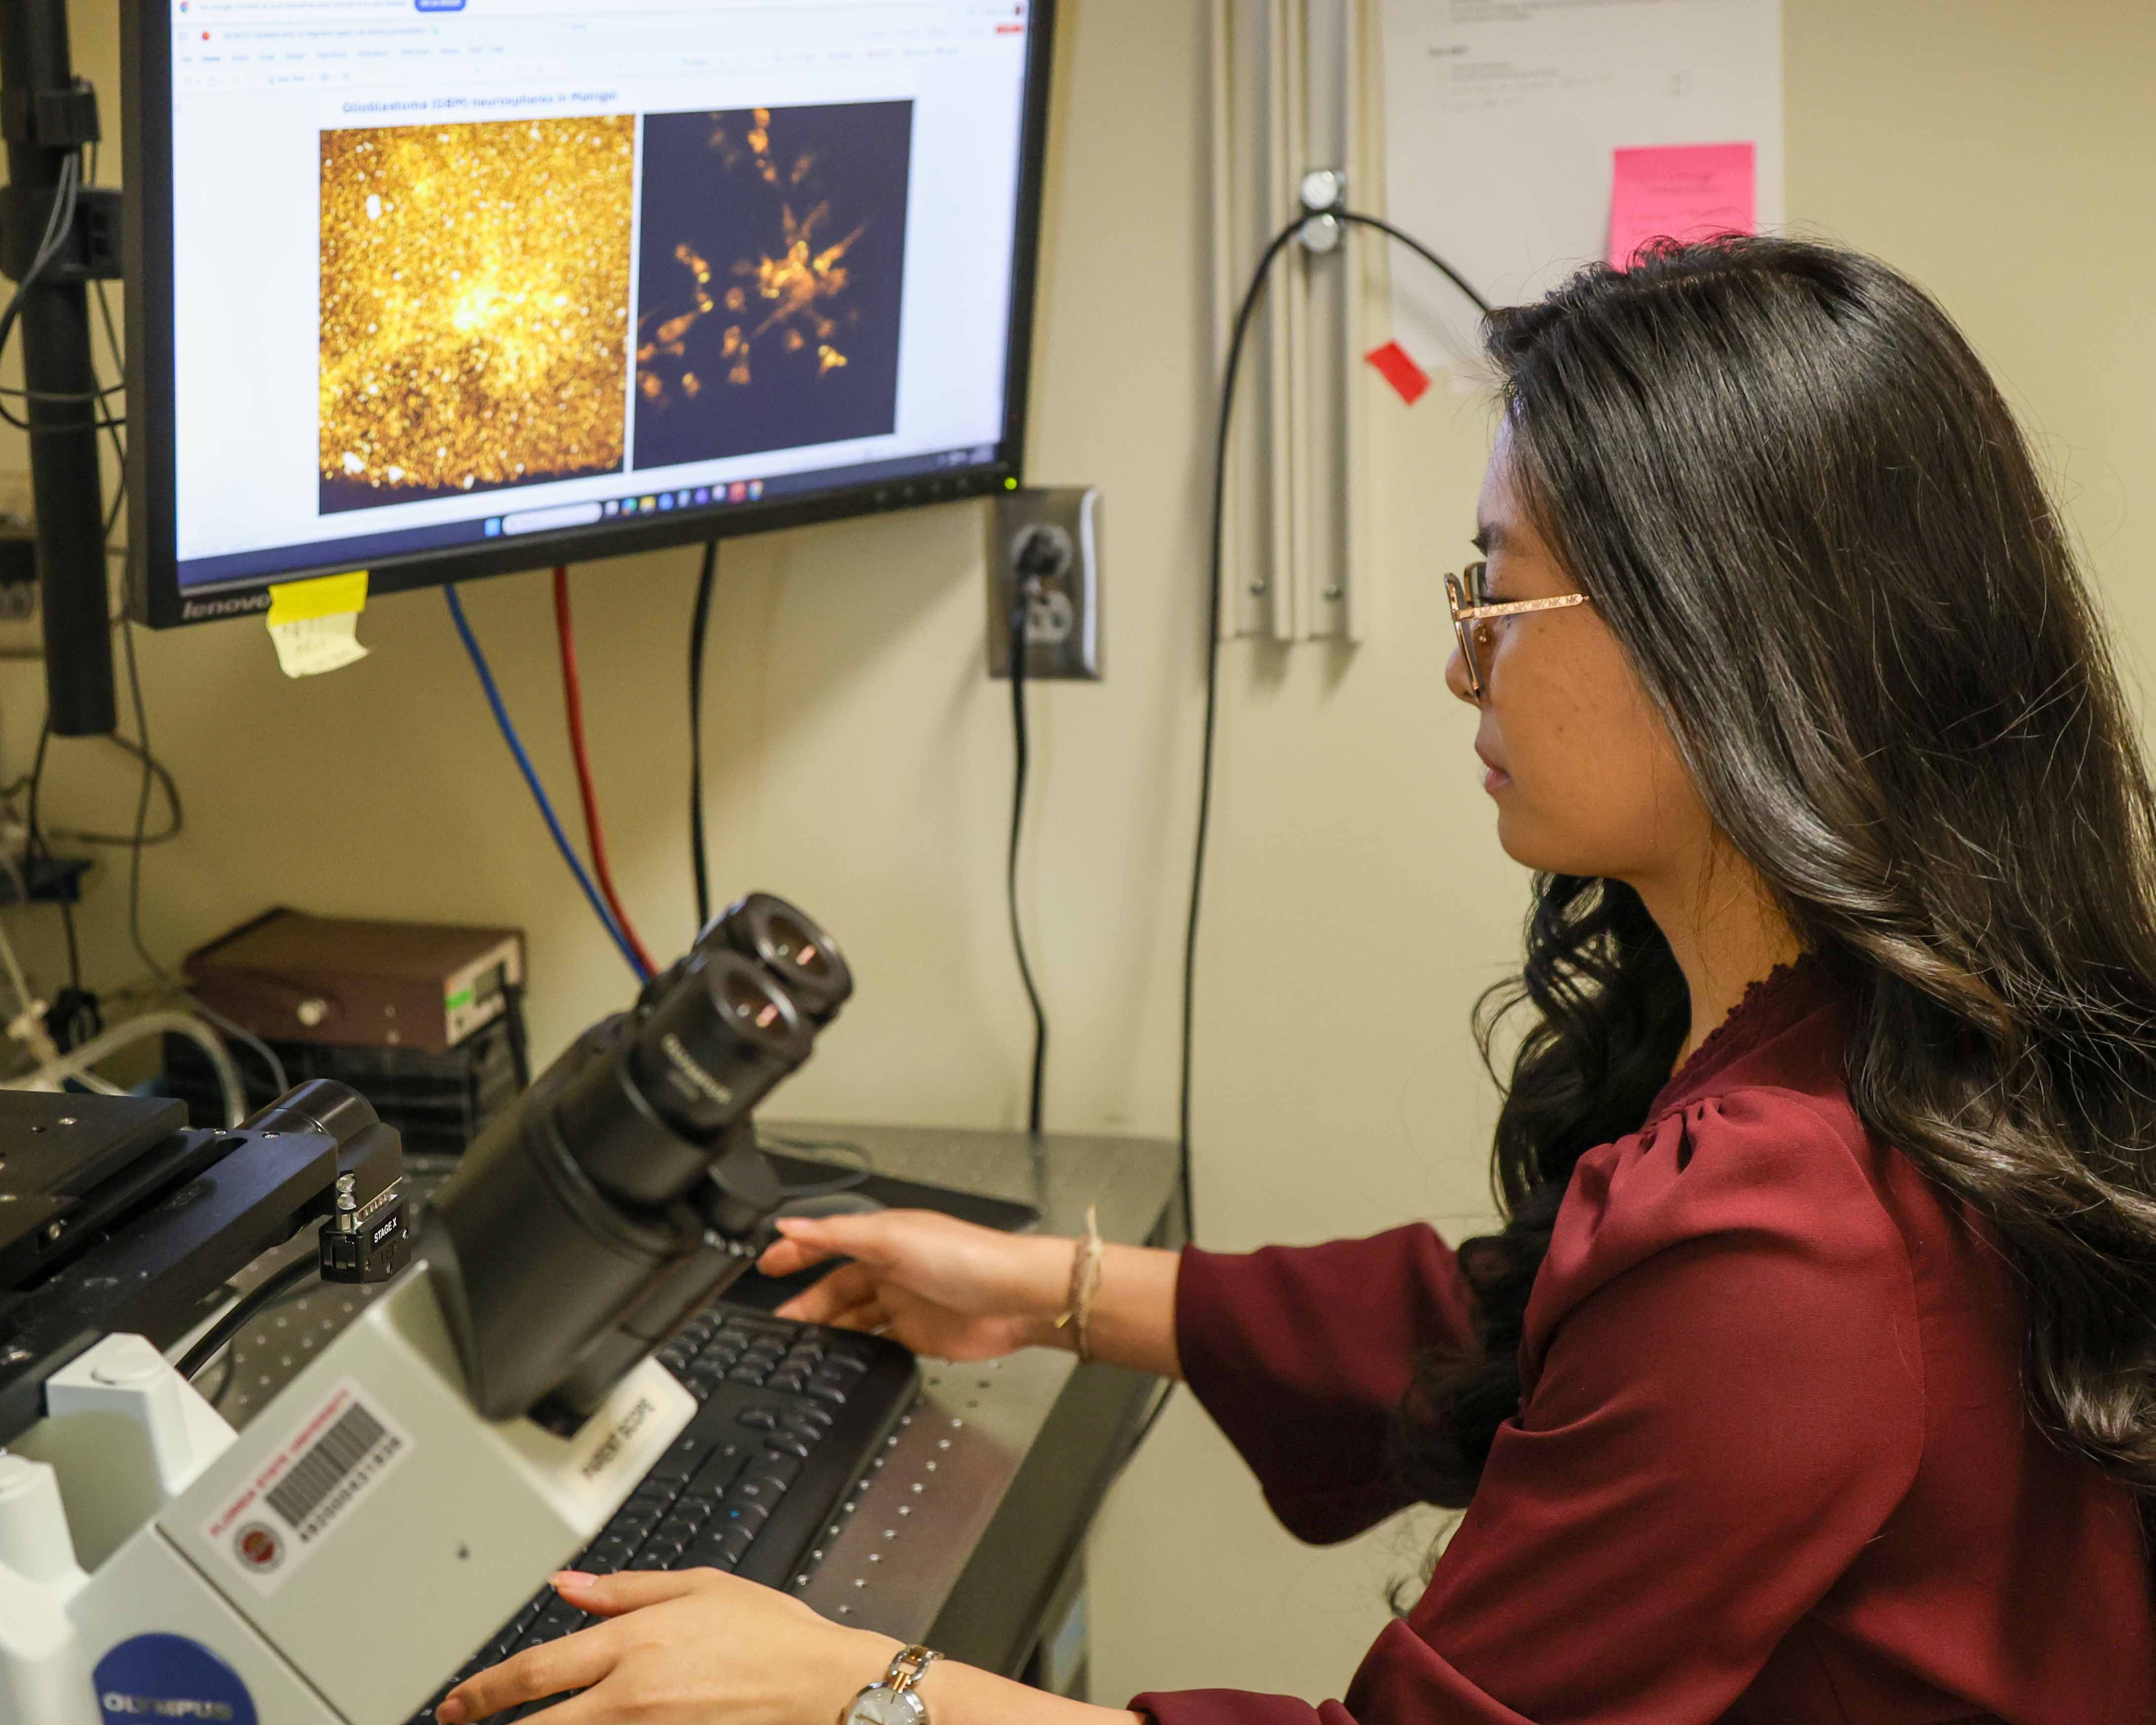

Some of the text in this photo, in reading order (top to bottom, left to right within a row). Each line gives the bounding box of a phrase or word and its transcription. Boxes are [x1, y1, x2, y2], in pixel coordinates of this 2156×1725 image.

[182, 594, 273, 619] lenovo
[374, 1216, 397, 1244] STAGE X
[103, 1691, 233, 1721] OLYMPUS
